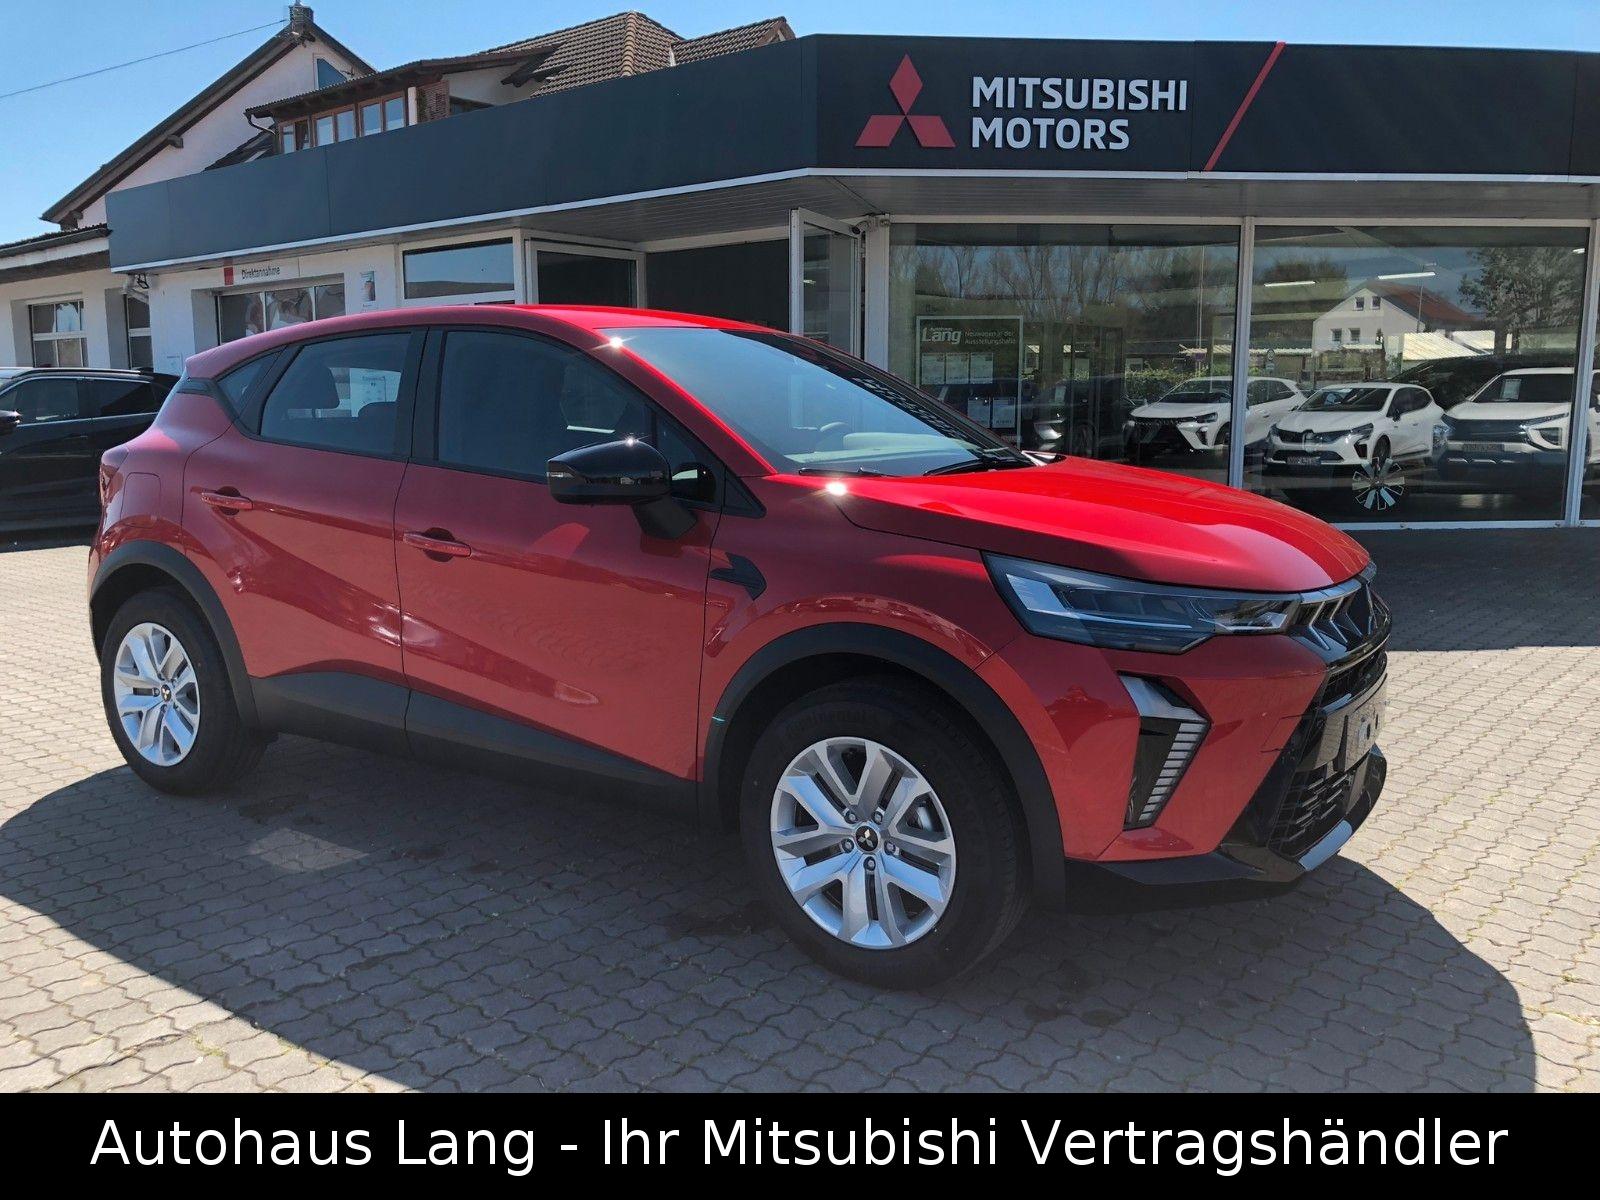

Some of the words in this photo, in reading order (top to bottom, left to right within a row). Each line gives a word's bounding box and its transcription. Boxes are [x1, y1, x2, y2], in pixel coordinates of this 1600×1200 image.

[972, 76, 1188, 112] MITSUBISHI
[972, 117, 1130, 150] MOTORS
[241, 266, 280, 280] Direktannahme
[921, 328, 961, 344] Lang
